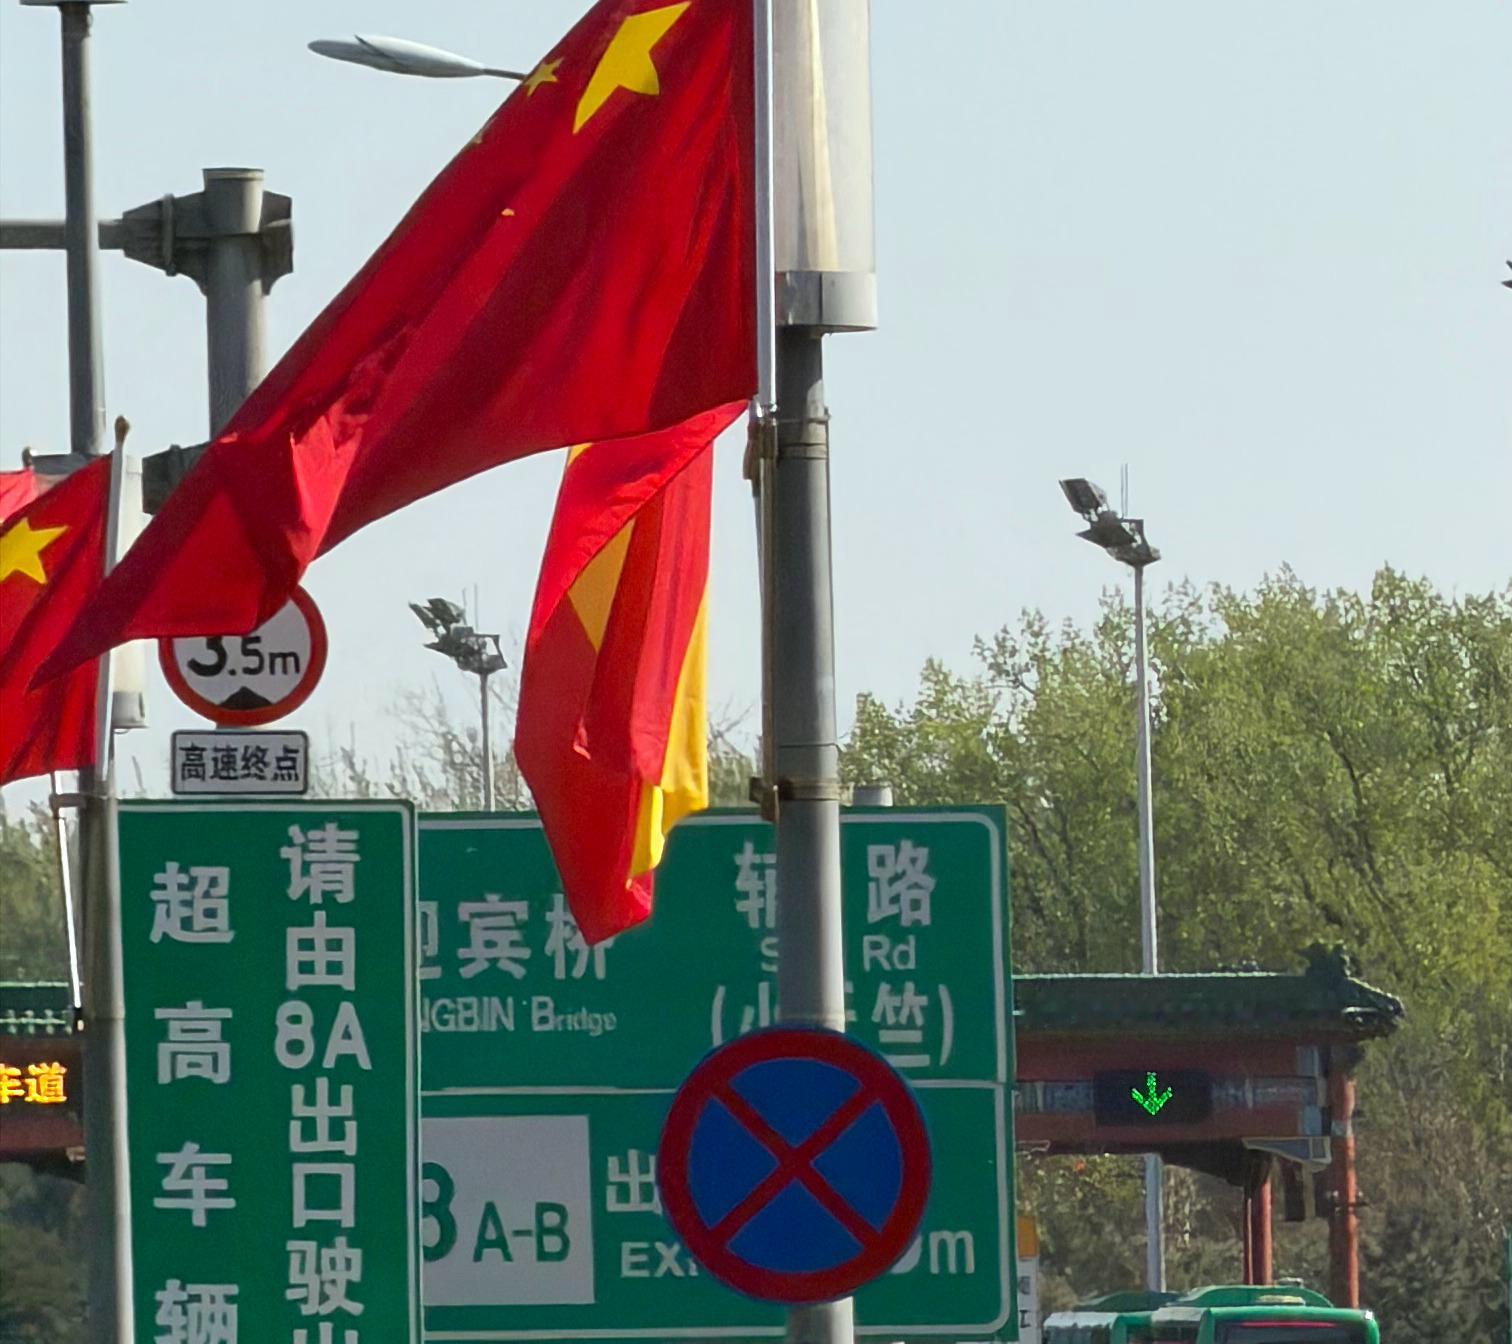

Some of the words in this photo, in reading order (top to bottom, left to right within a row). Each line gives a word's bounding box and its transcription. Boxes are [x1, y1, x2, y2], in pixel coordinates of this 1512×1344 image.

[178, 742, 300, 783] 高速终点
[862, 935, 916, 971] Rd
[531, 996, 617, 1036] Bridge
